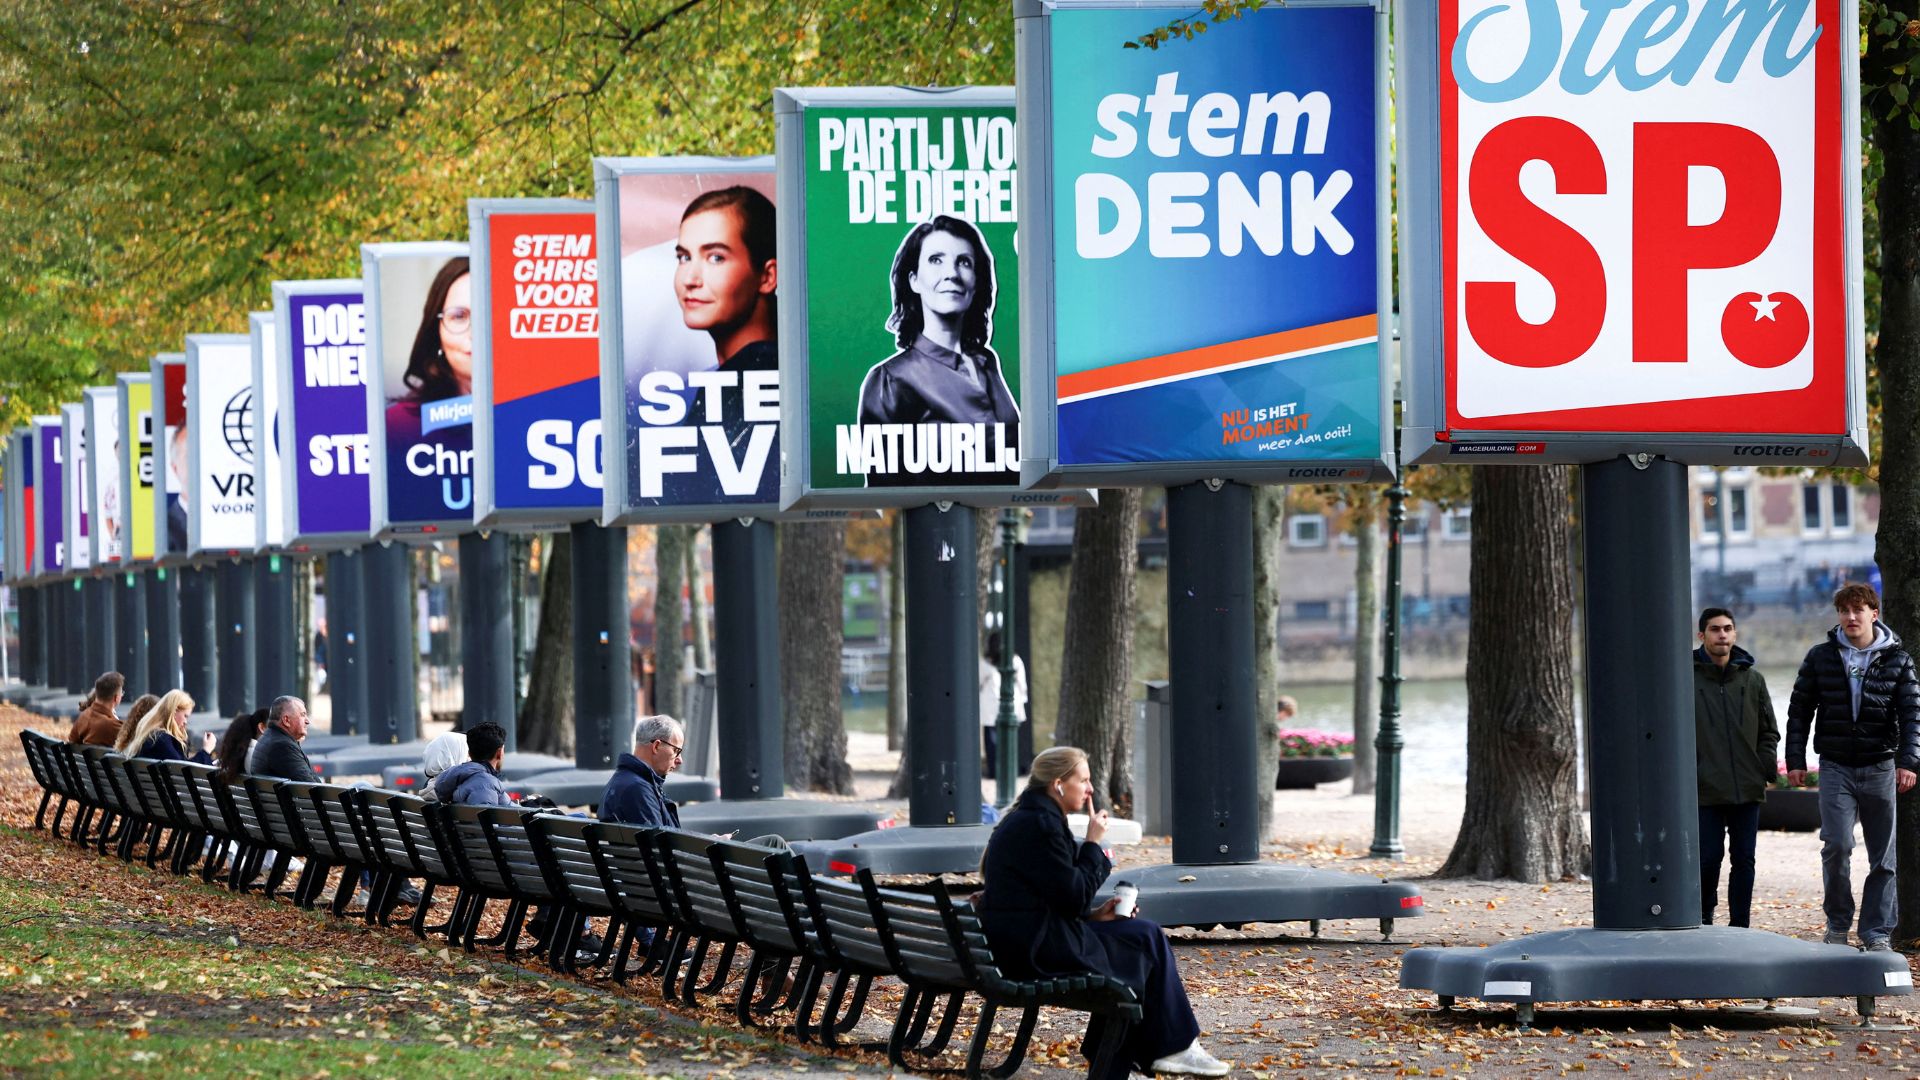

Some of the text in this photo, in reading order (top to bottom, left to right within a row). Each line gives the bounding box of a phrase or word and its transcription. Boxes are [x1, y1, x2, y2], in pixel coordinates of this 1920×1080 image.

[1451, 0, 1824, 104] Stem
[1091, 71, 1332, 158] stem
[818, 116, 1018, 171] PARTIJ VO
[848, 170, 1018, 223] DE DIERE
[1075, 169, 1355, 259] DENK
[512, 234, 593, 258] STEM
[513, 258, 598, 282] CHRIS
[515, 283, 595, 306] VOOR
[302, 303, 366, 346] DOE
[638, 370, 781, 425] STE
[1221, 402, 1297, 428] NU IS HET
[1222, 413, 1312, 446] MOMENT
[1258, 423, 1352, 452] meer dan ooit!
[309, 433, 369, 477] STE
[406, 443, 474, 477] Chr
[638, 424, 778, 498] FV
[211, 473, 254, 497] VR
[443, 477, 472, 511] U
[211, 503, 254, 514] VOOR
